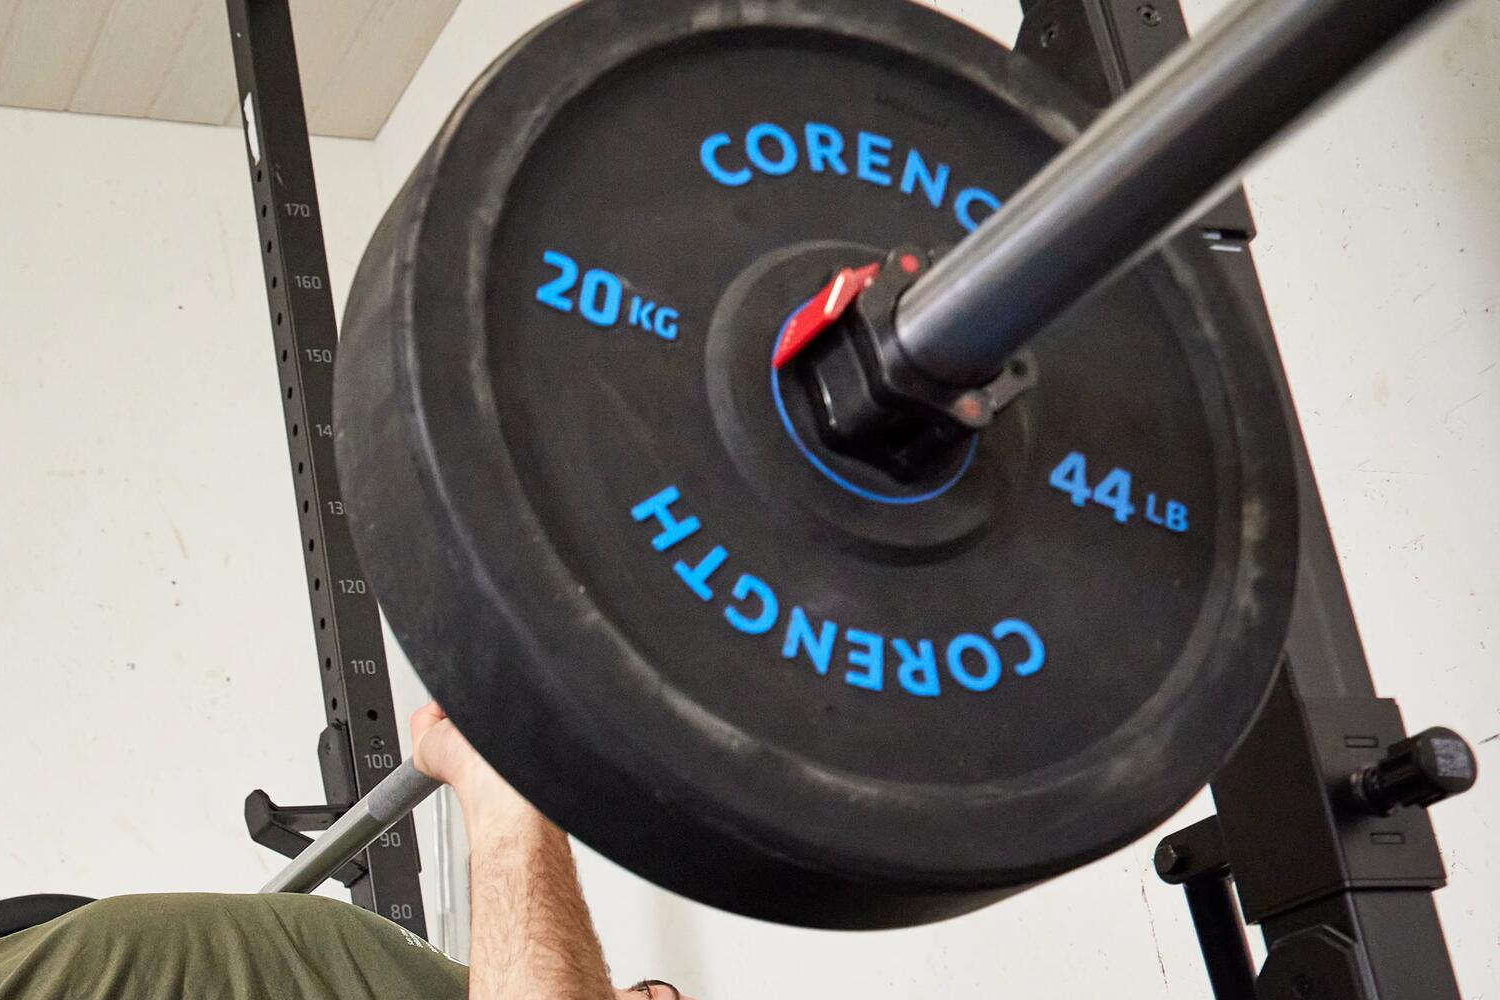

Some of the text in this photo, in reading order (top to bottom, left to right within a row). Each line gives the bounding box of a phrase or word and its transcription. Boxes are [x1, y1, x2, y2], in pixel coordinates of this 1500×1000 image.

[700, 122, 1002, 234] CORENG
[284, 203, 310, 217] 170
[294, 275, 322, 289] 160
[535, 250, 680, 341] 20 KG
[305, 349, 332, 363] 150
[316, 424, 333, 437] 14
[1049, 452, 1190, 533] 44 LB
[327, 501, 347, 515] 13
[338, 579, 366, 594] 120
[630, 484, 1046, 698] CORENGTH
[350, 660, 376, 675] 110
[363, 753, 394, 769] 100
[380, 831, 402, 847] 90
[390, 904, 413, 920] 80
